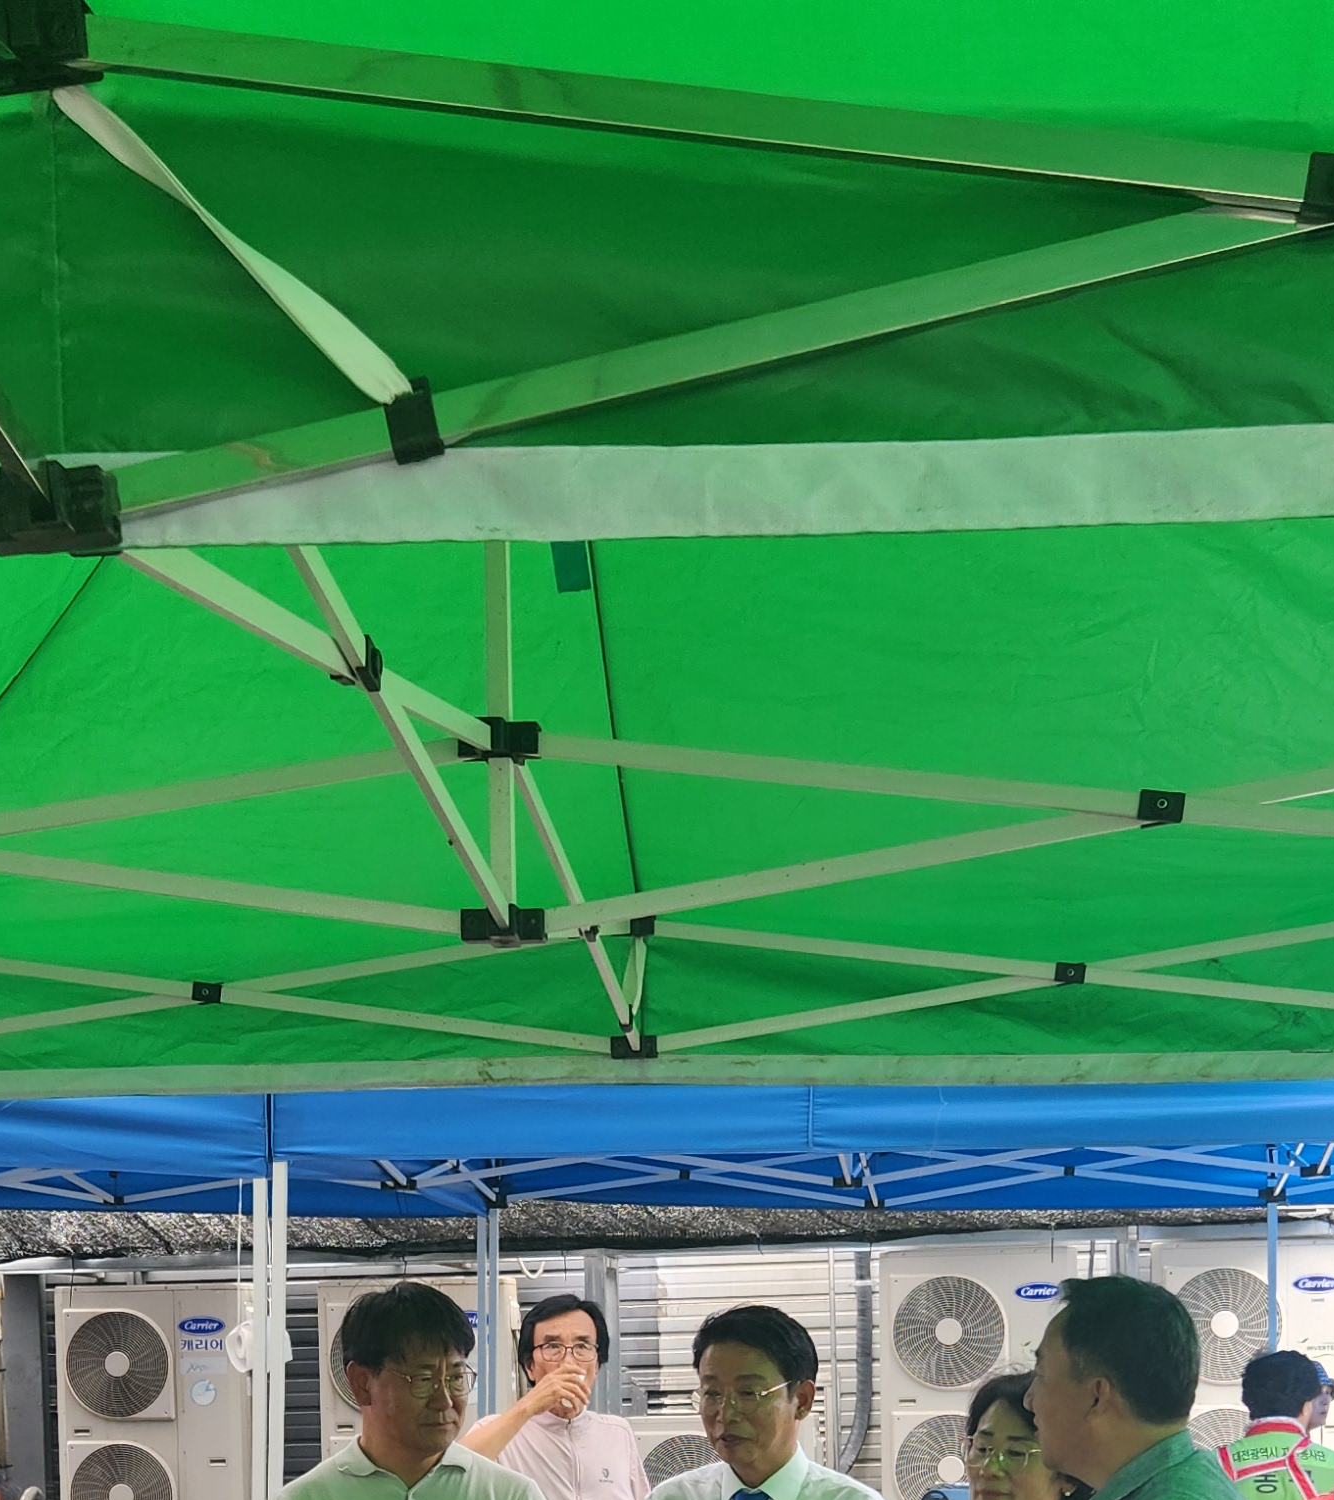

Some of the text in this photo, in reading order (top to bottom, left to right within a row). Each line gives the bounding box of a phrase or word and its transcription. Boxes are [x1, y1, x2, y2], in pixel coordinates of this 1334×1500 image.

[1020, 1285, 1058, 1298] Carrier
[183, 1318, 221, 1332] Carrier
[180, 1338, 224, 1351] 캐리어
[1231, 1445, 1279, 1463] 대전광역시
